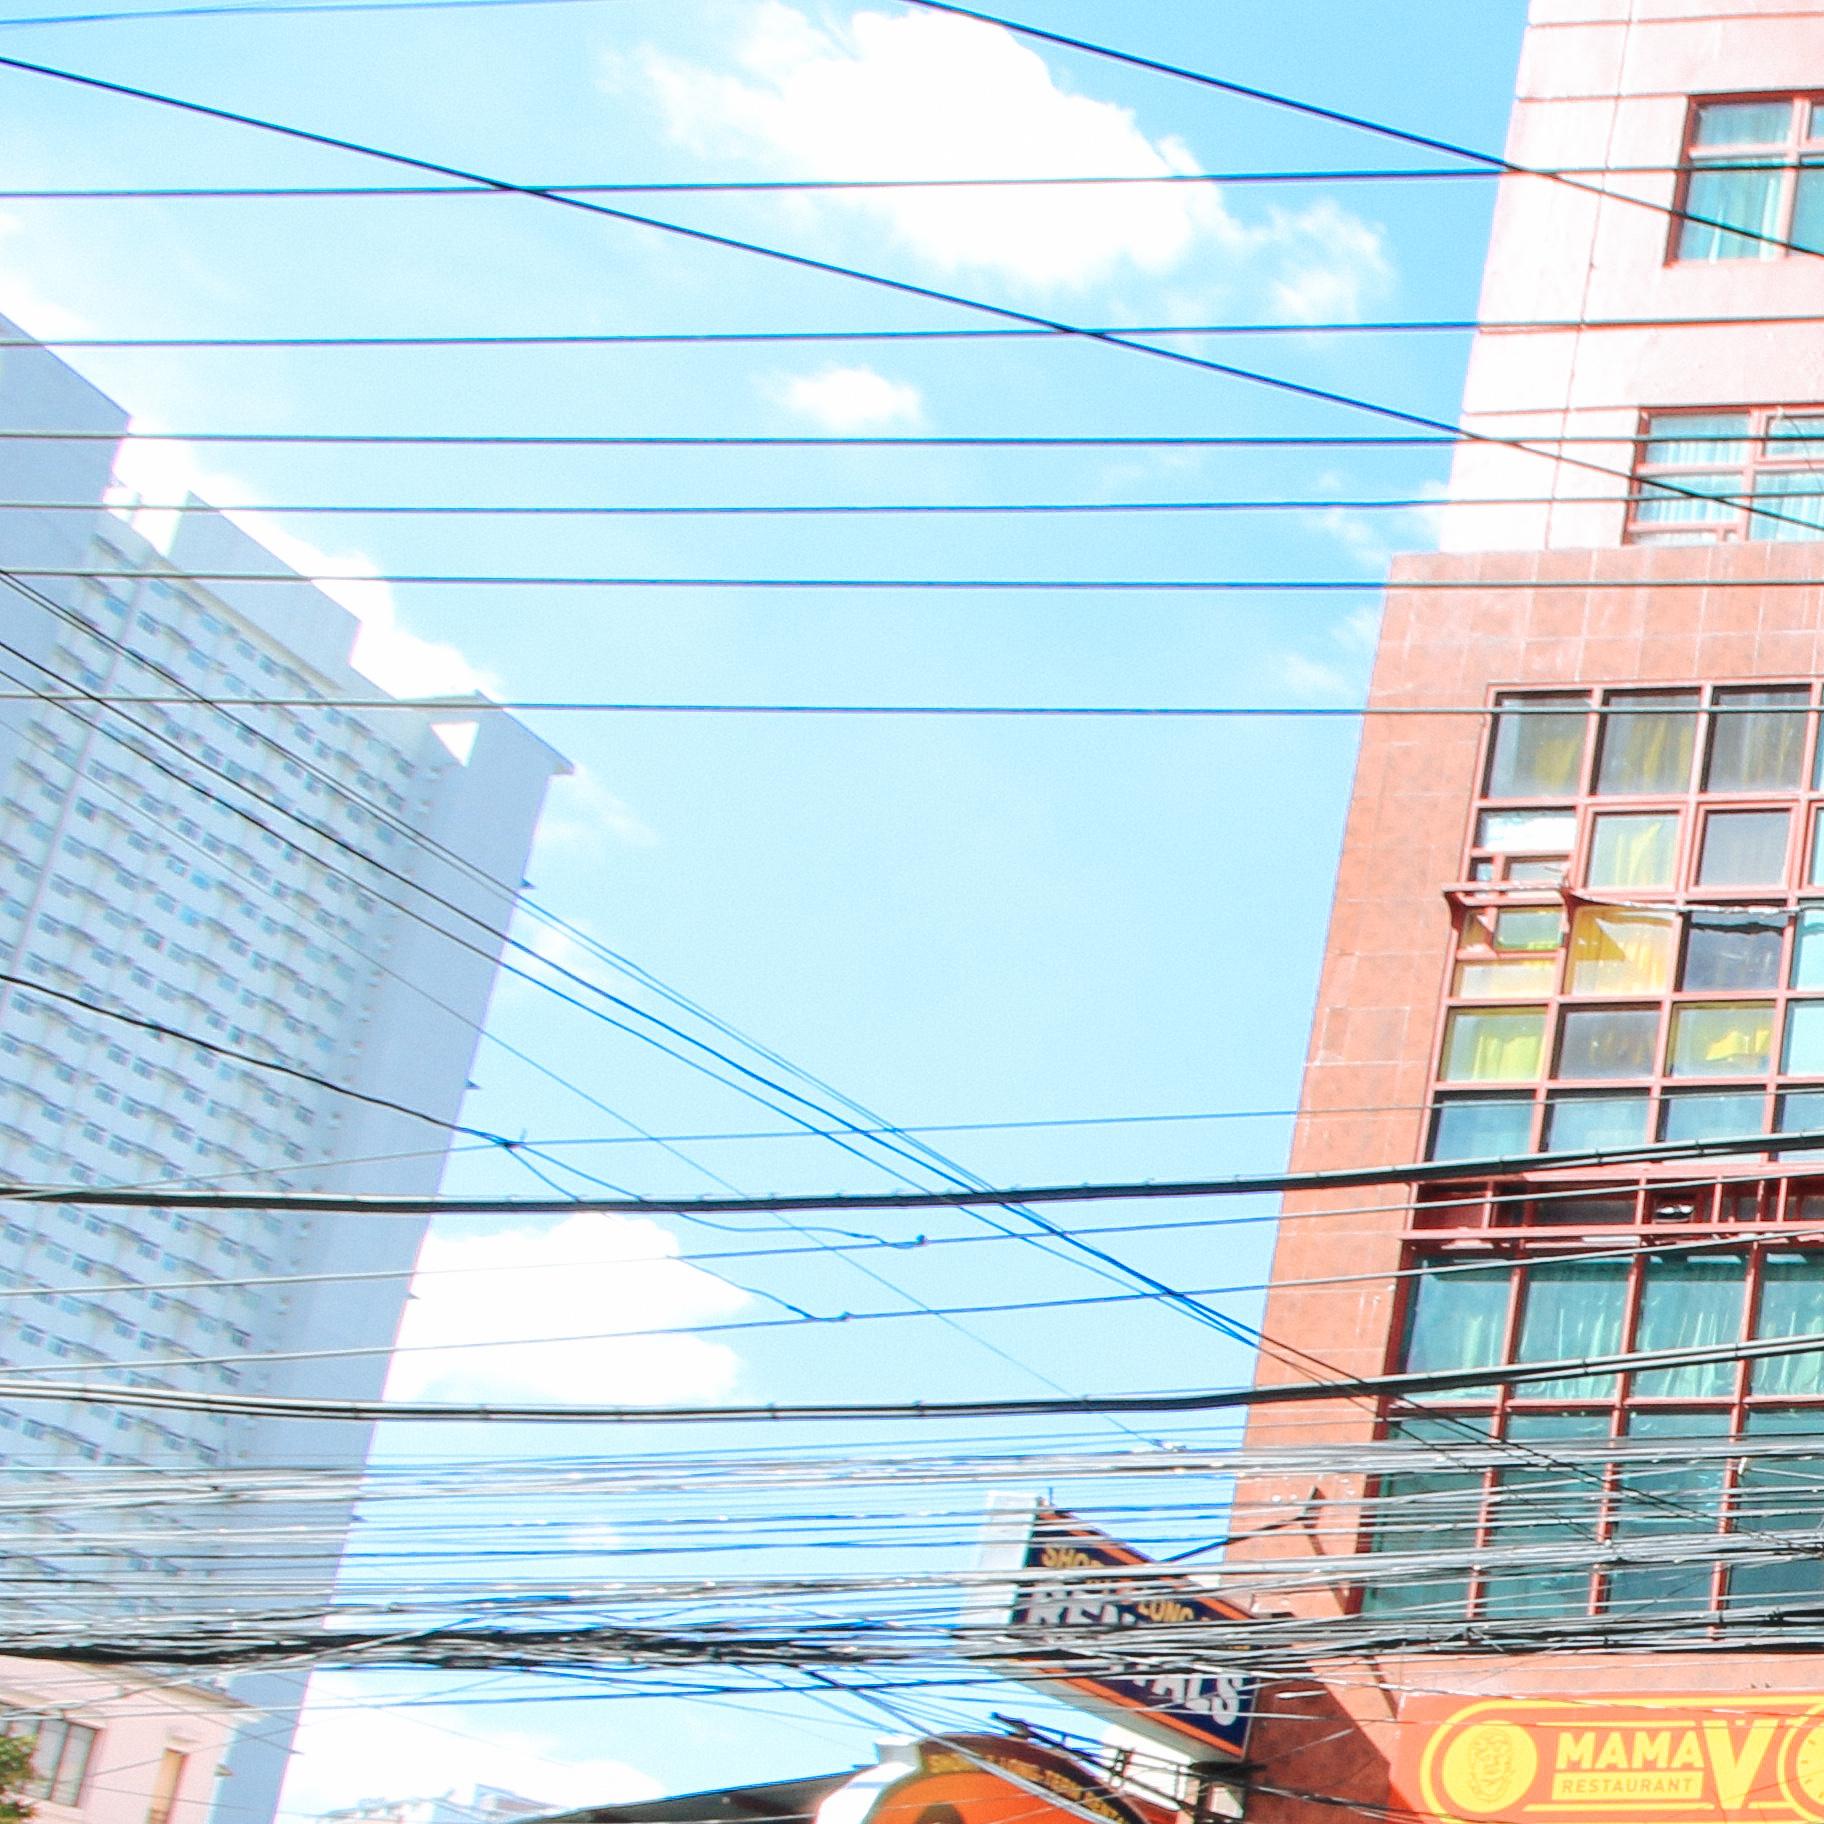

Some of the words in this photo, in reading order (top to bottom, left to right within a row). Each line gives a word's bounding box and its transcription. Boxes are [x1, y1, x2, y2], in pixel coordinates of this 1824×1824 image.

[1555, 1730, 1705, 1771] MAMA
[1702, 1719, 1780, 1810] V
[1562, 1777, 1694, 1795] RESTAURANT
